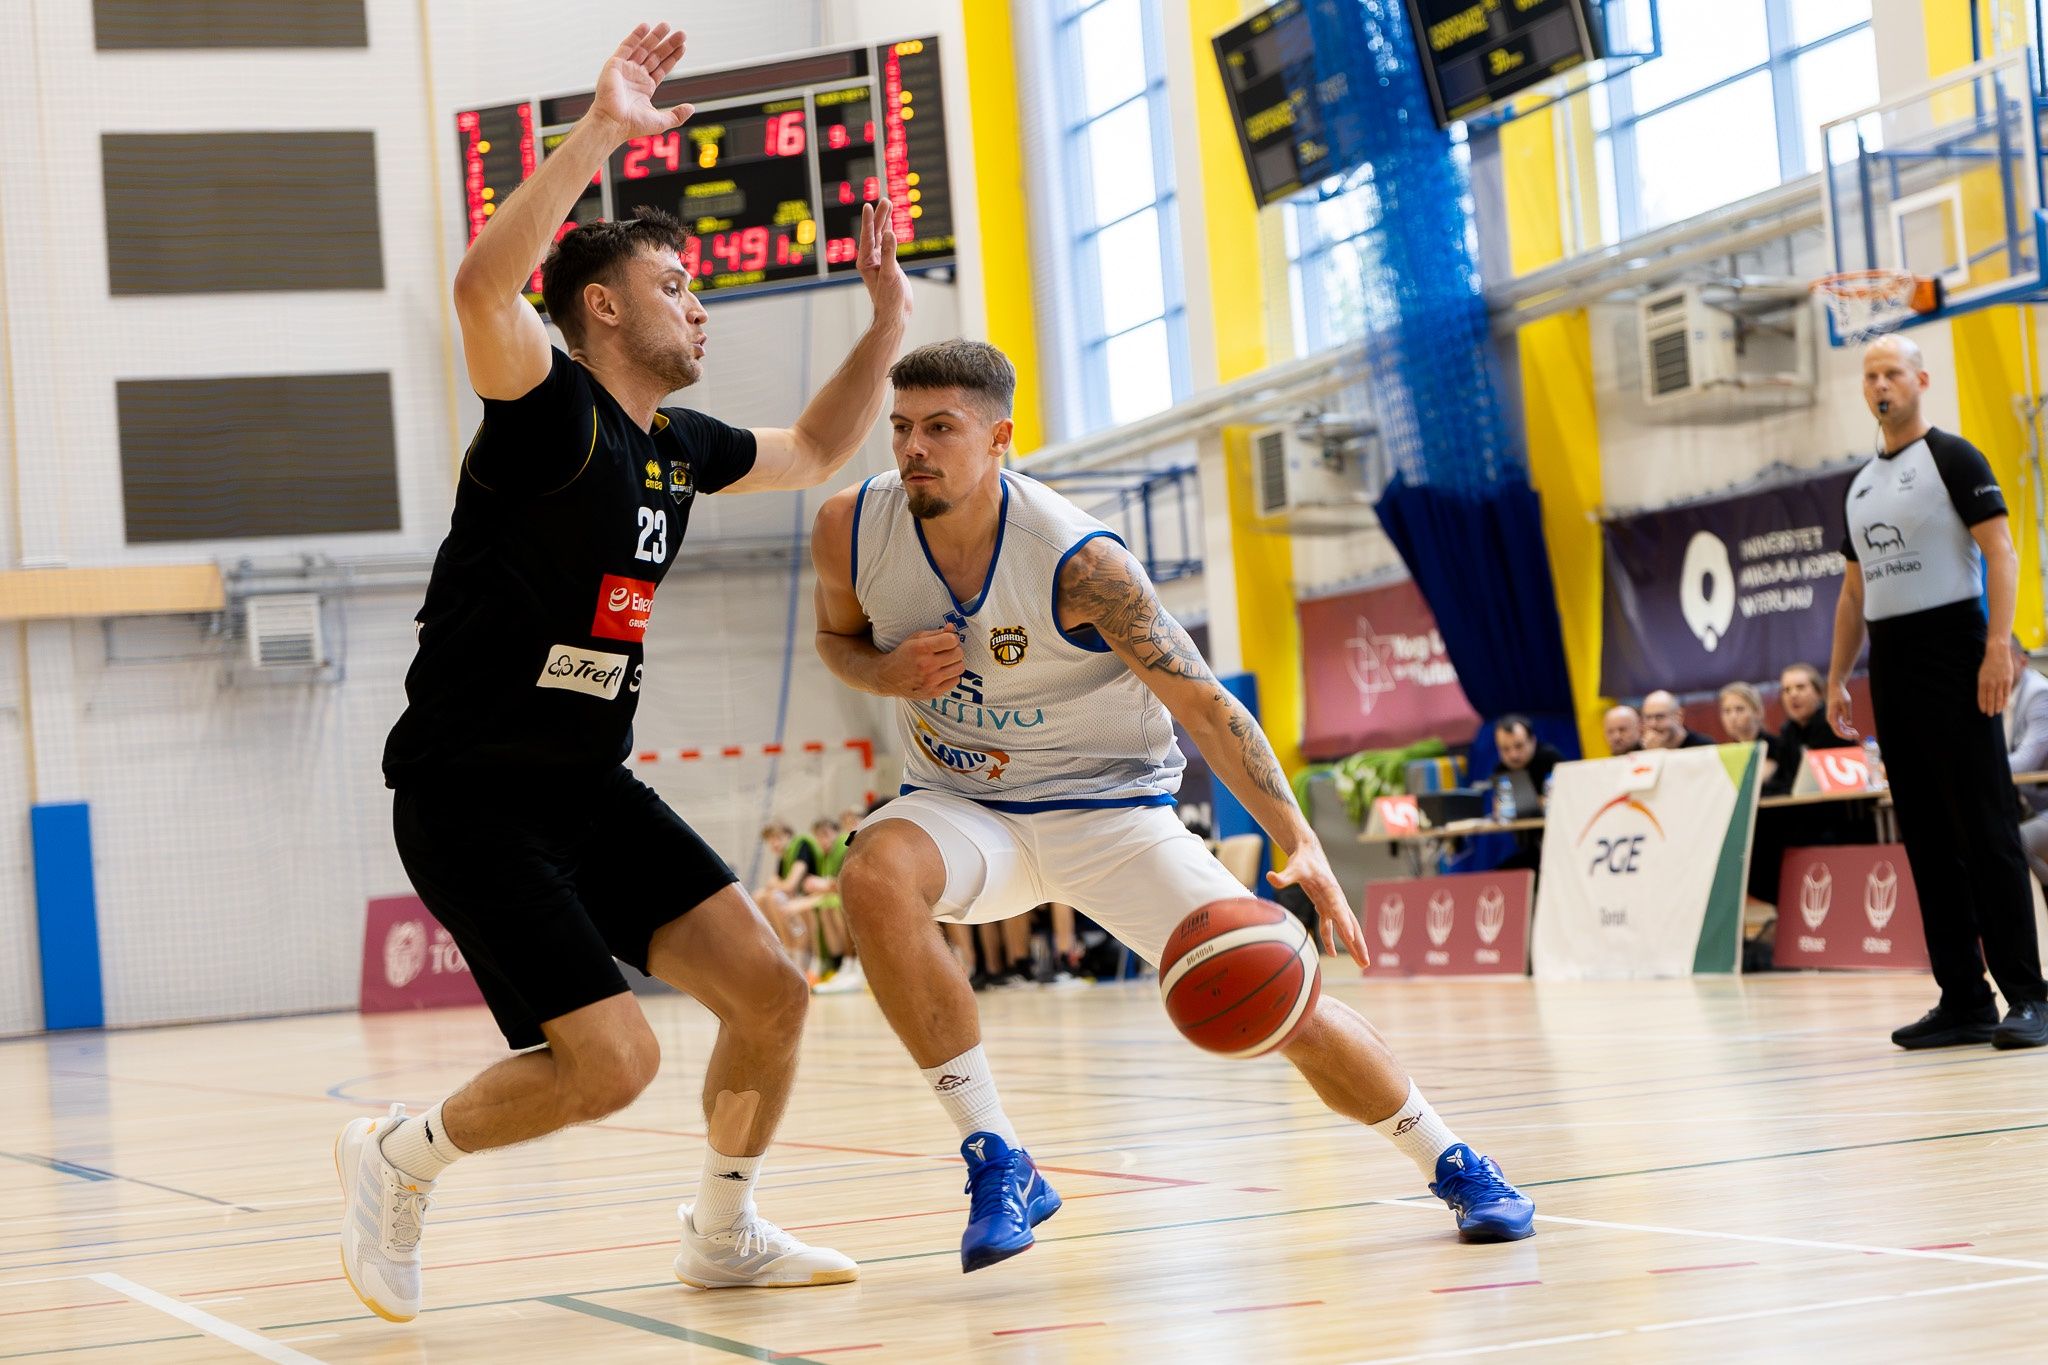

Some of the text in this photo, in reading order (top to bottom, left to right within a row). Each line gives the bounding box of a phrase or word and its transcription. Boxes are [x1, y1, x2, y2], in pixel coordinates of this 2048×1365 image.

[624, 131, 680, 180] 24
[765, 111, 806, 156] 16
[635, 507, 667, 564] 23
[1885, 560, 1922, 577] Pekao
[991, 633, 1027, 646] TWARDE
[573, 659, 622, 689] Trefl
[1589, 835, 1646, 878] PGE
[429, 942, 470, 974] TO
